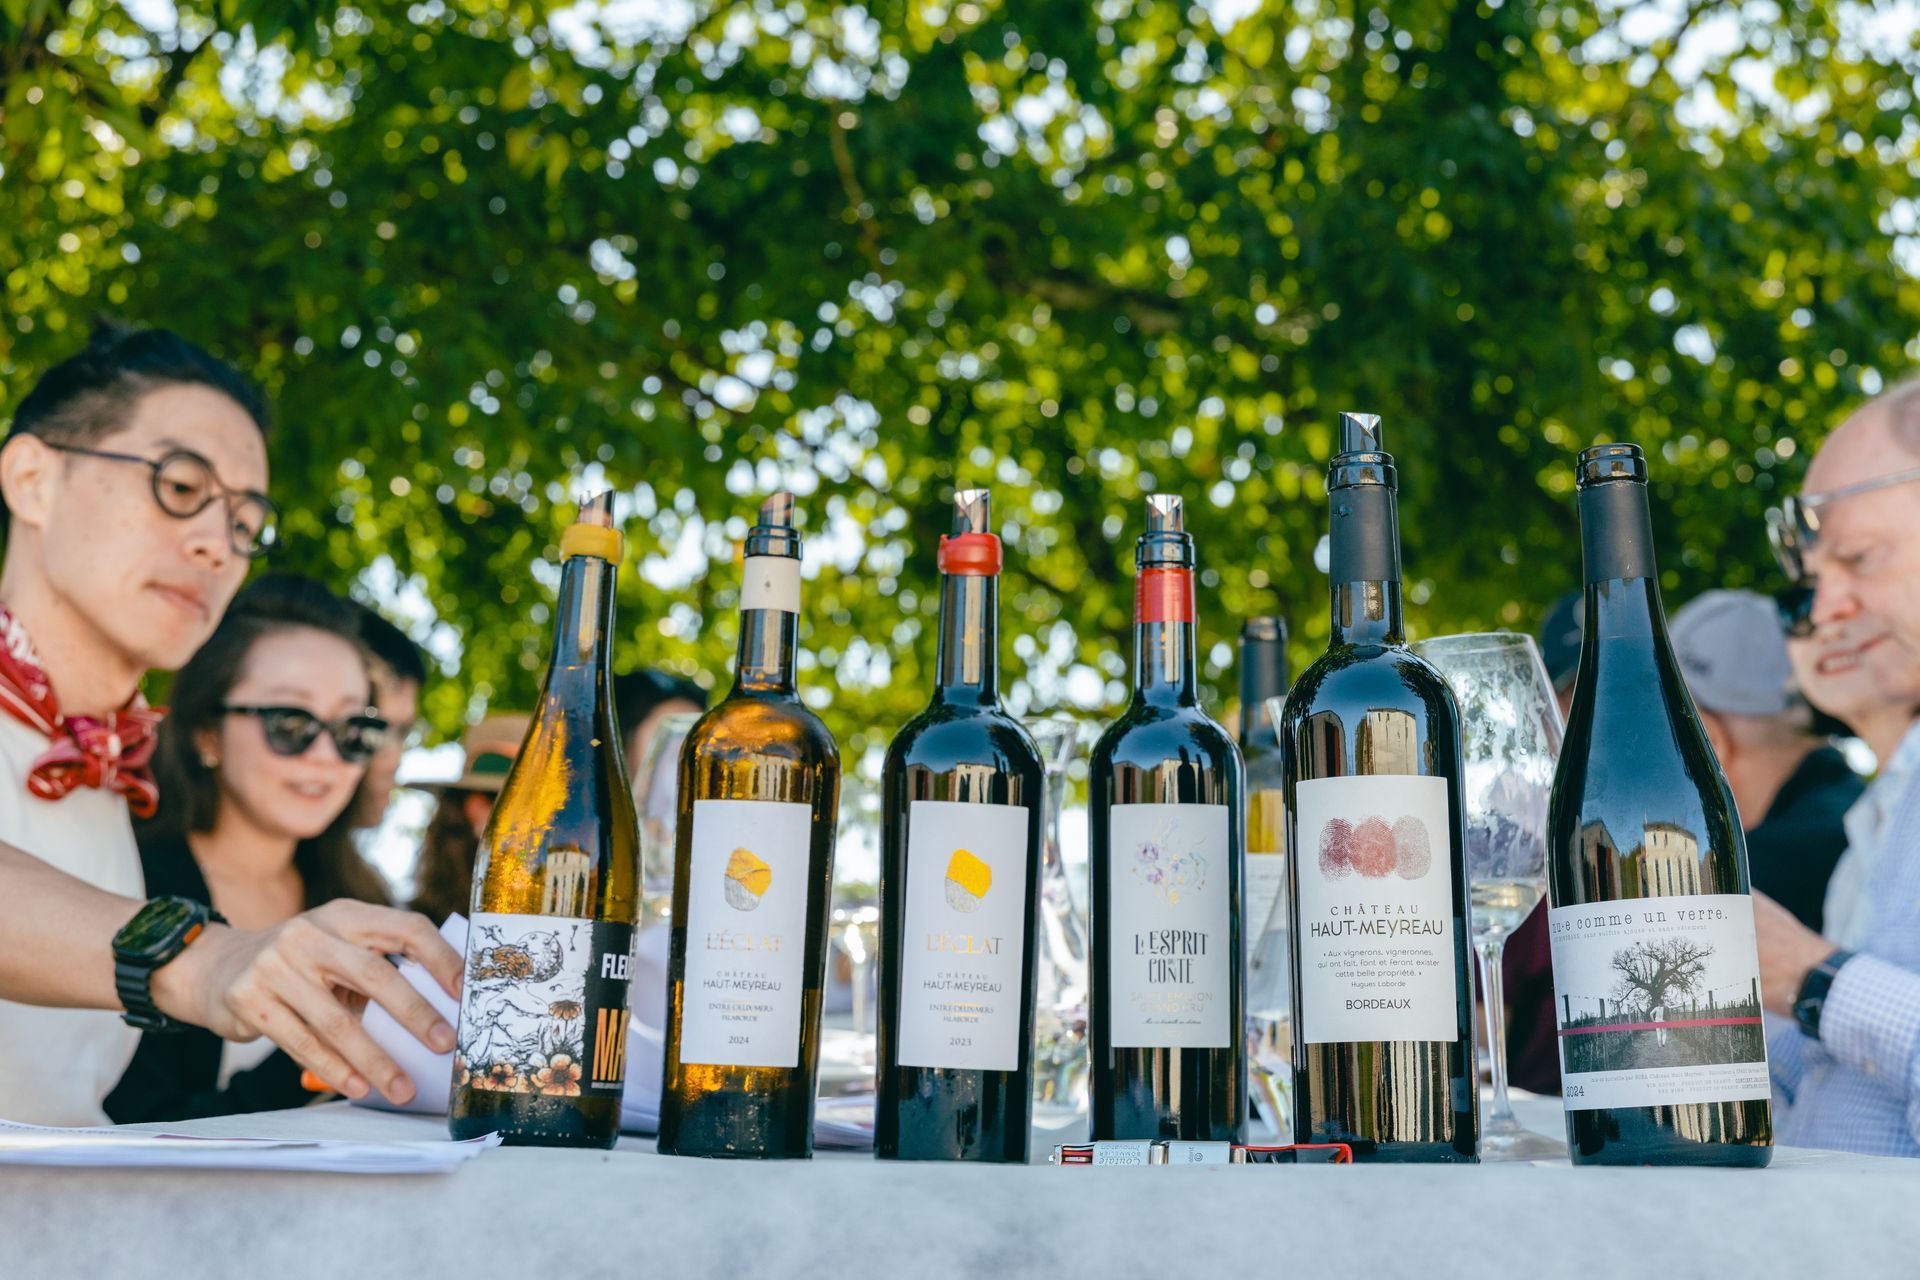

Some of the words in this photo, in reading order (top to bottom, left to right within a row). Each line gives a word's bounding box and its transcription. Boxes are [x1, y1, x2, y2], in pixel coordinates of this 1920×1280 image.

[1330, 903, 1419, 916] CHÂTEAU
[1577, 912, 1633, 928] comme
[1643, 911, 1666, 923] un
[1677, 907, 1729, 921] verre.
[1311, 920, 1443, 938] HAUT-MEYREAU
[1317, 960, 1328, 969] qui
[1360, 959, 1376, 967] font
[1389, 958, 1414, 966] feront
[1416, 958, 1440, 966] exister
[1148, 958, 1195, 984] CONTE
[1335, 970, 1355, 978] cette
[1356, 969, 1376, 977] belle
[703, 978, 782, 993] HAUT-MEYREAU
[923, 980, 1002, 994] HAUT-MEYREAU
[1351, 981, 1376, 989] Hugues
[1377, 980, 1407, 988] Laborde
[1346, 998, 1411, 1010] BORDEAUX
[728, 1035, 750, 1045] 2024
[949, 1037, 973, 1047] 2023
[1566, 1085, 1585, 1097] 2024
